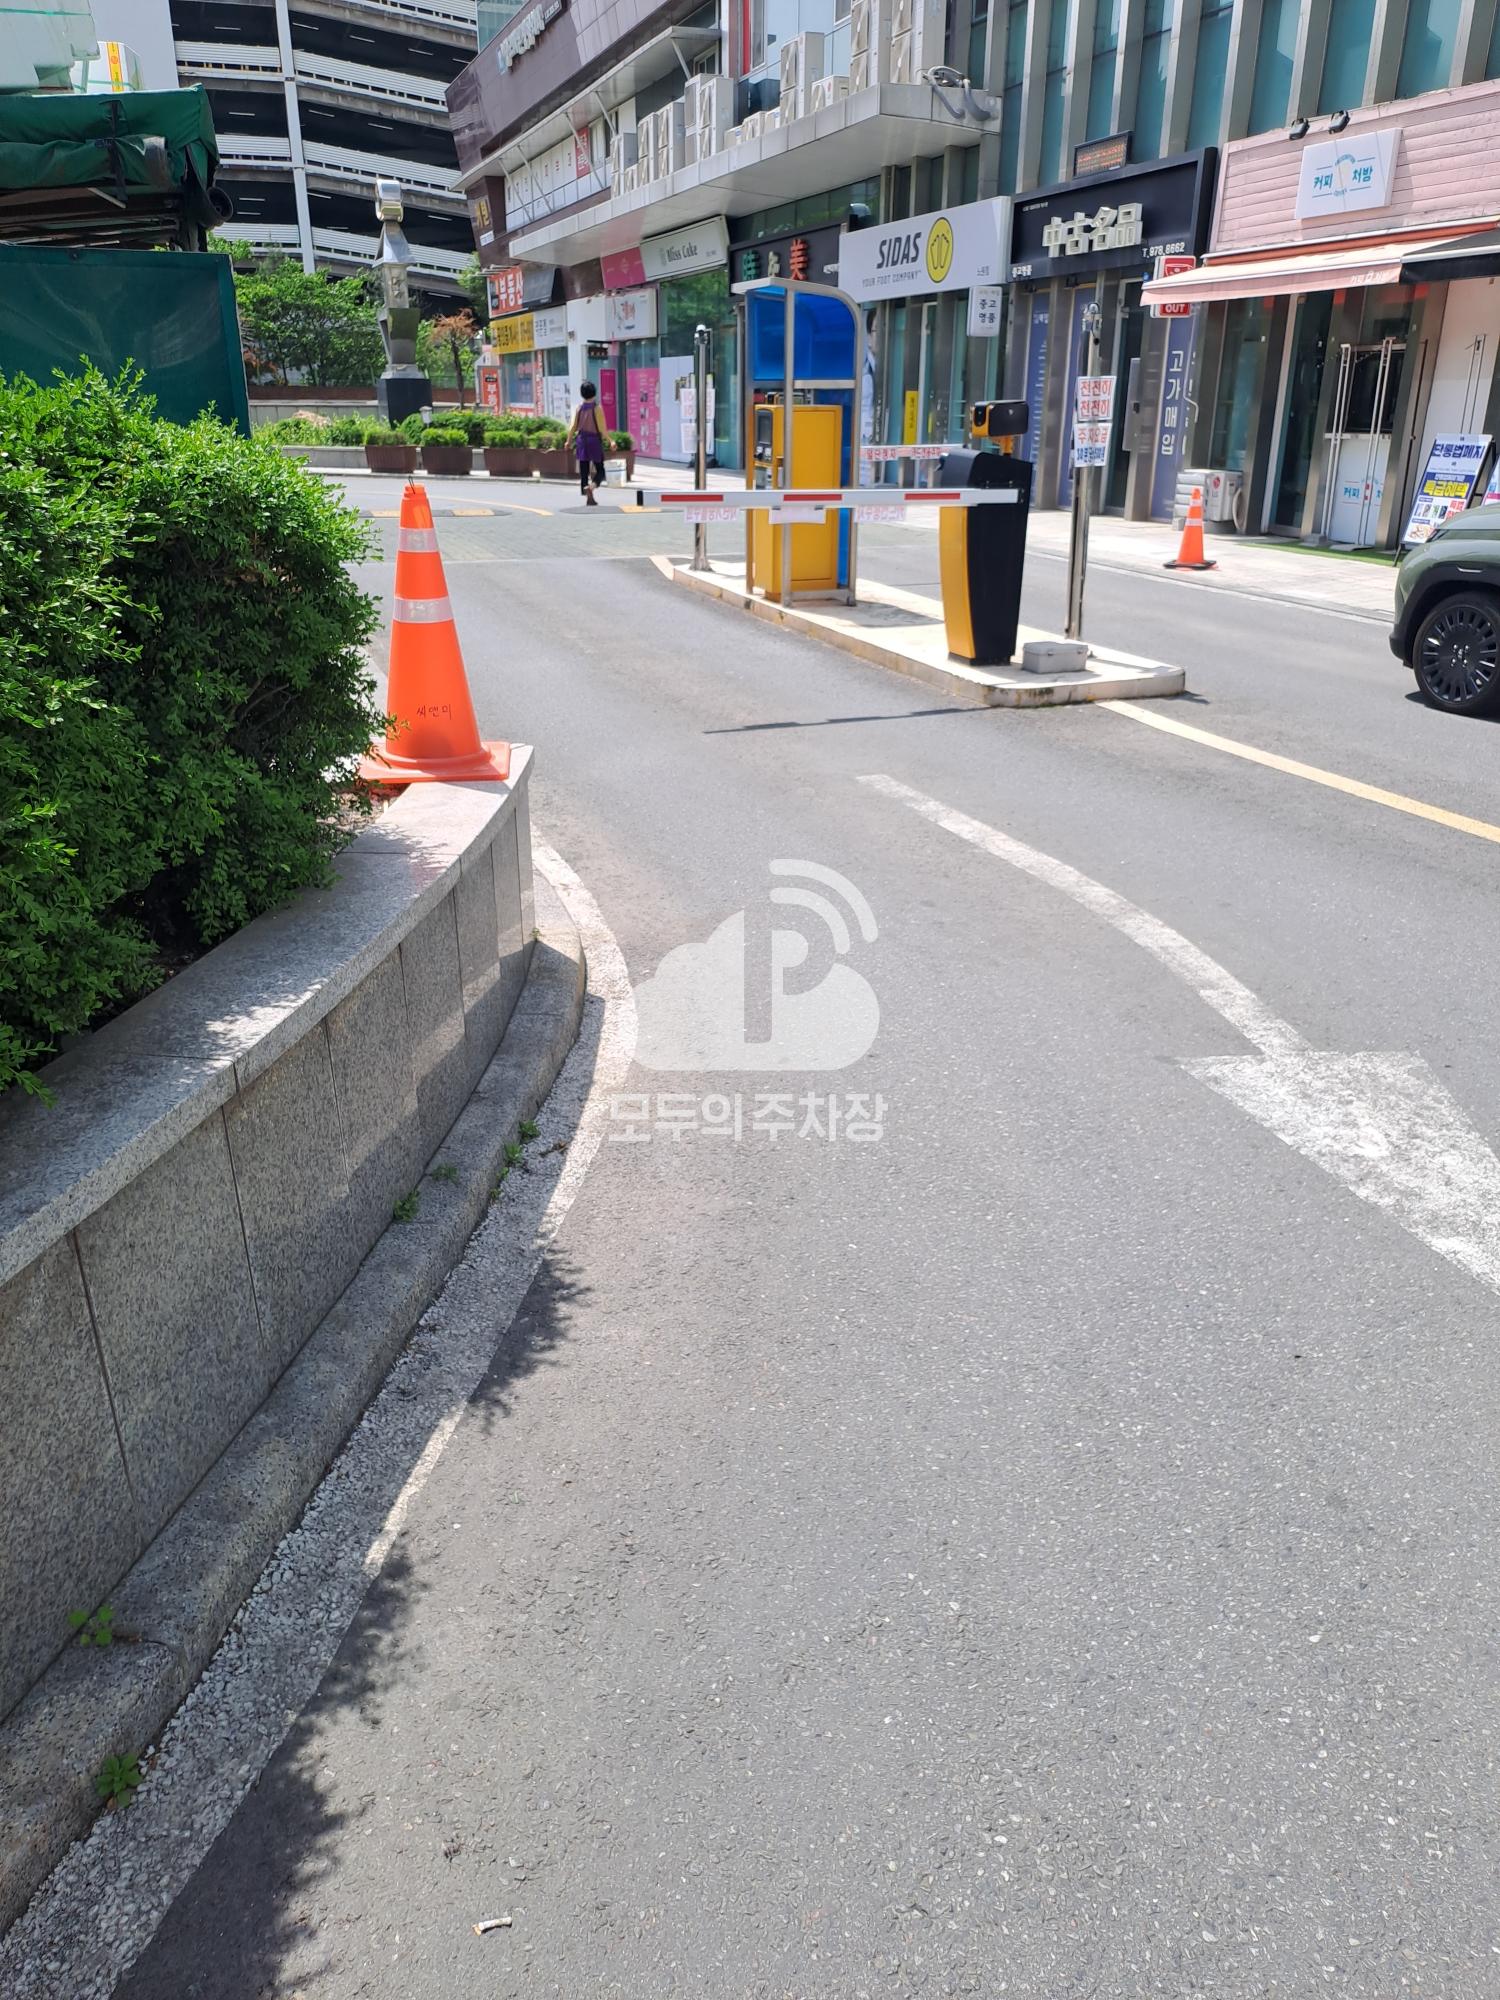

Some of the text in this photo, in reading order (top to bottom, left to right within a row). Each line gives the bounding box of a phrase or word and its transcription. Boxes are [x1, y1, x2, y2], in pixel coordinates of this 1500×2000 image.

[1313, 165, 1373, 190] 커피 처방
[1042, 202, 1144, 258] 中古名品
[682, 241, 698, 258] Cake
[876, 231, 922, 269] SIDAS
[862, 276, 876, 288] YOUR
[877, 273, 891, 285] FOOT
[979, 299, 998, 310] 중고
[1165, 302, 1185, 314] OUT
[979, 312, 997, 324] 명품
[1161, 350, 1184, 456] 고가매입
